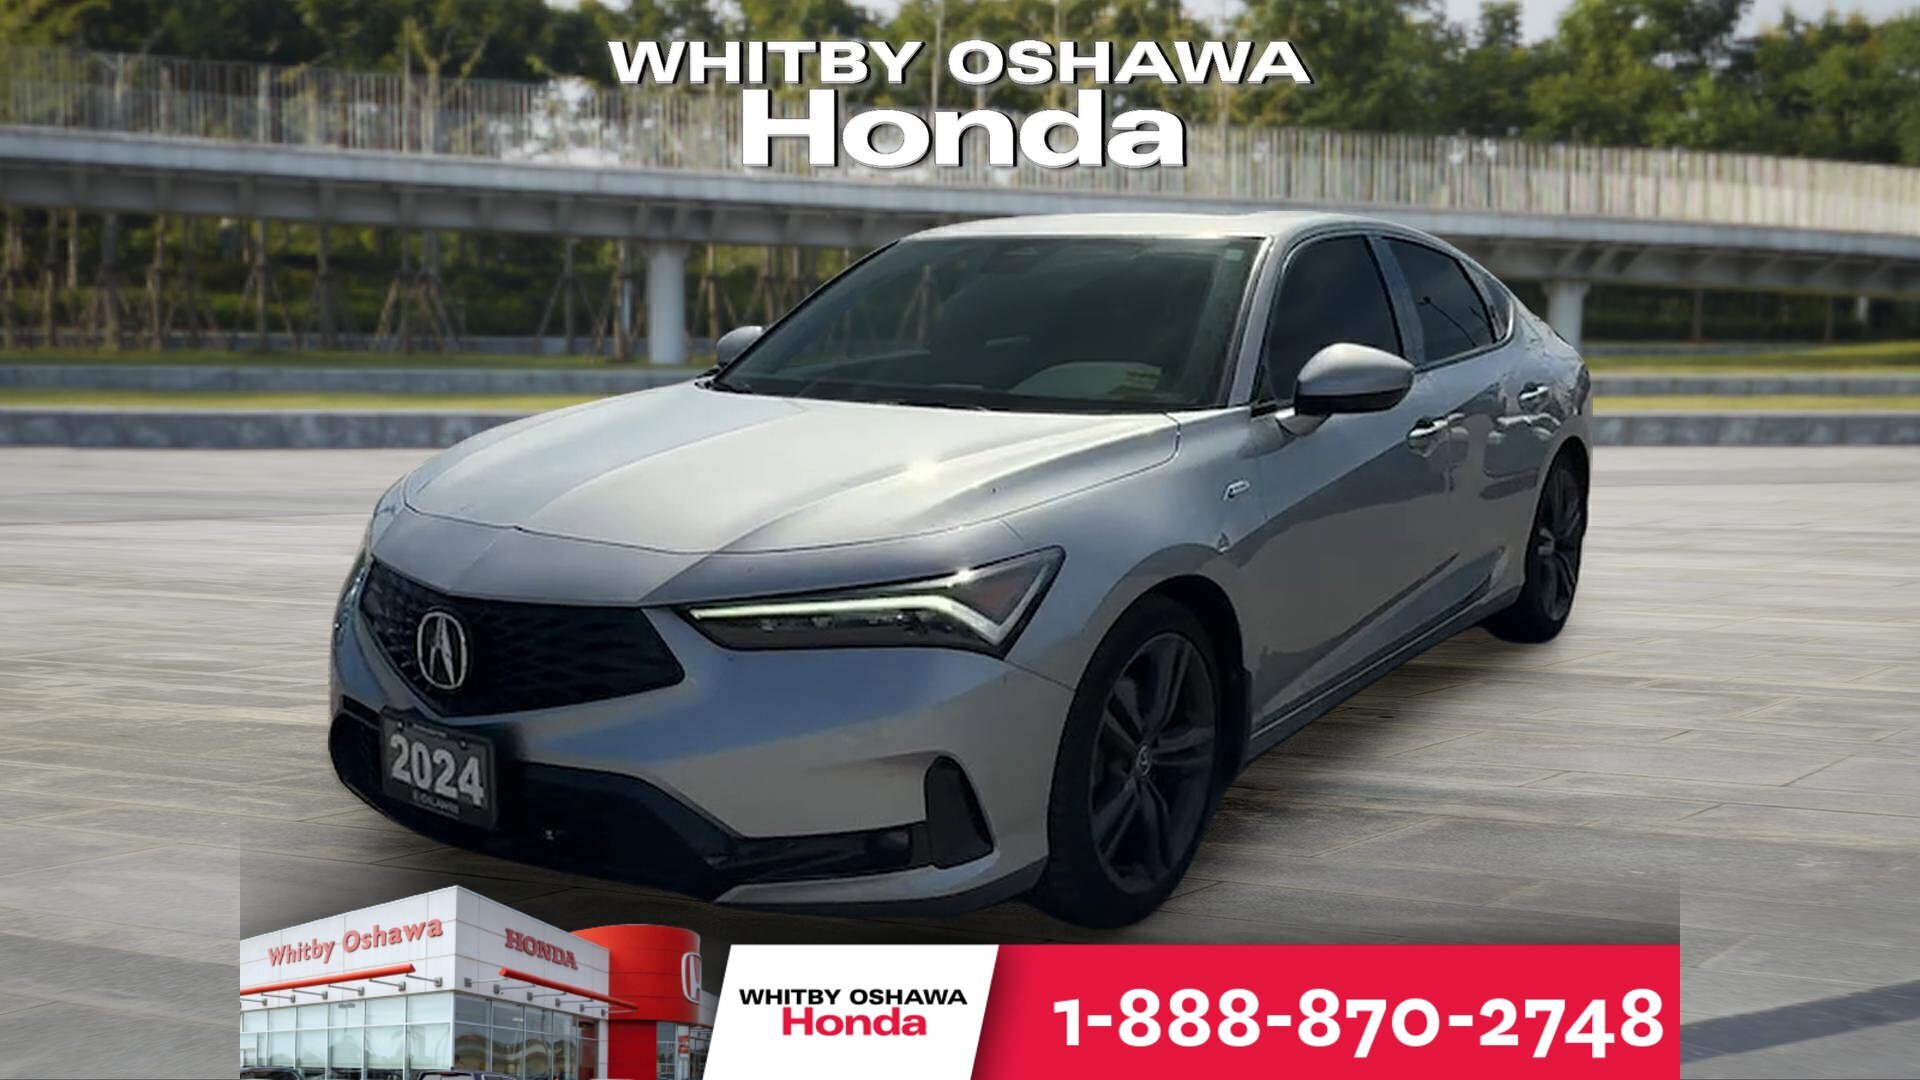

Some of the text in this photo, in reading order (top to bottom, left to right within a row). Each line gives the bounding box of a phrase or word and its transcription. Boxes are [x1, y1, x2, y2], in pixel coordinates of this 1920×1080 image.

[389, 733, 485, 808] 2024
[268, 918, 443, 966] Whitby Oshawa
[505, 927, 578, 970] HONDA
